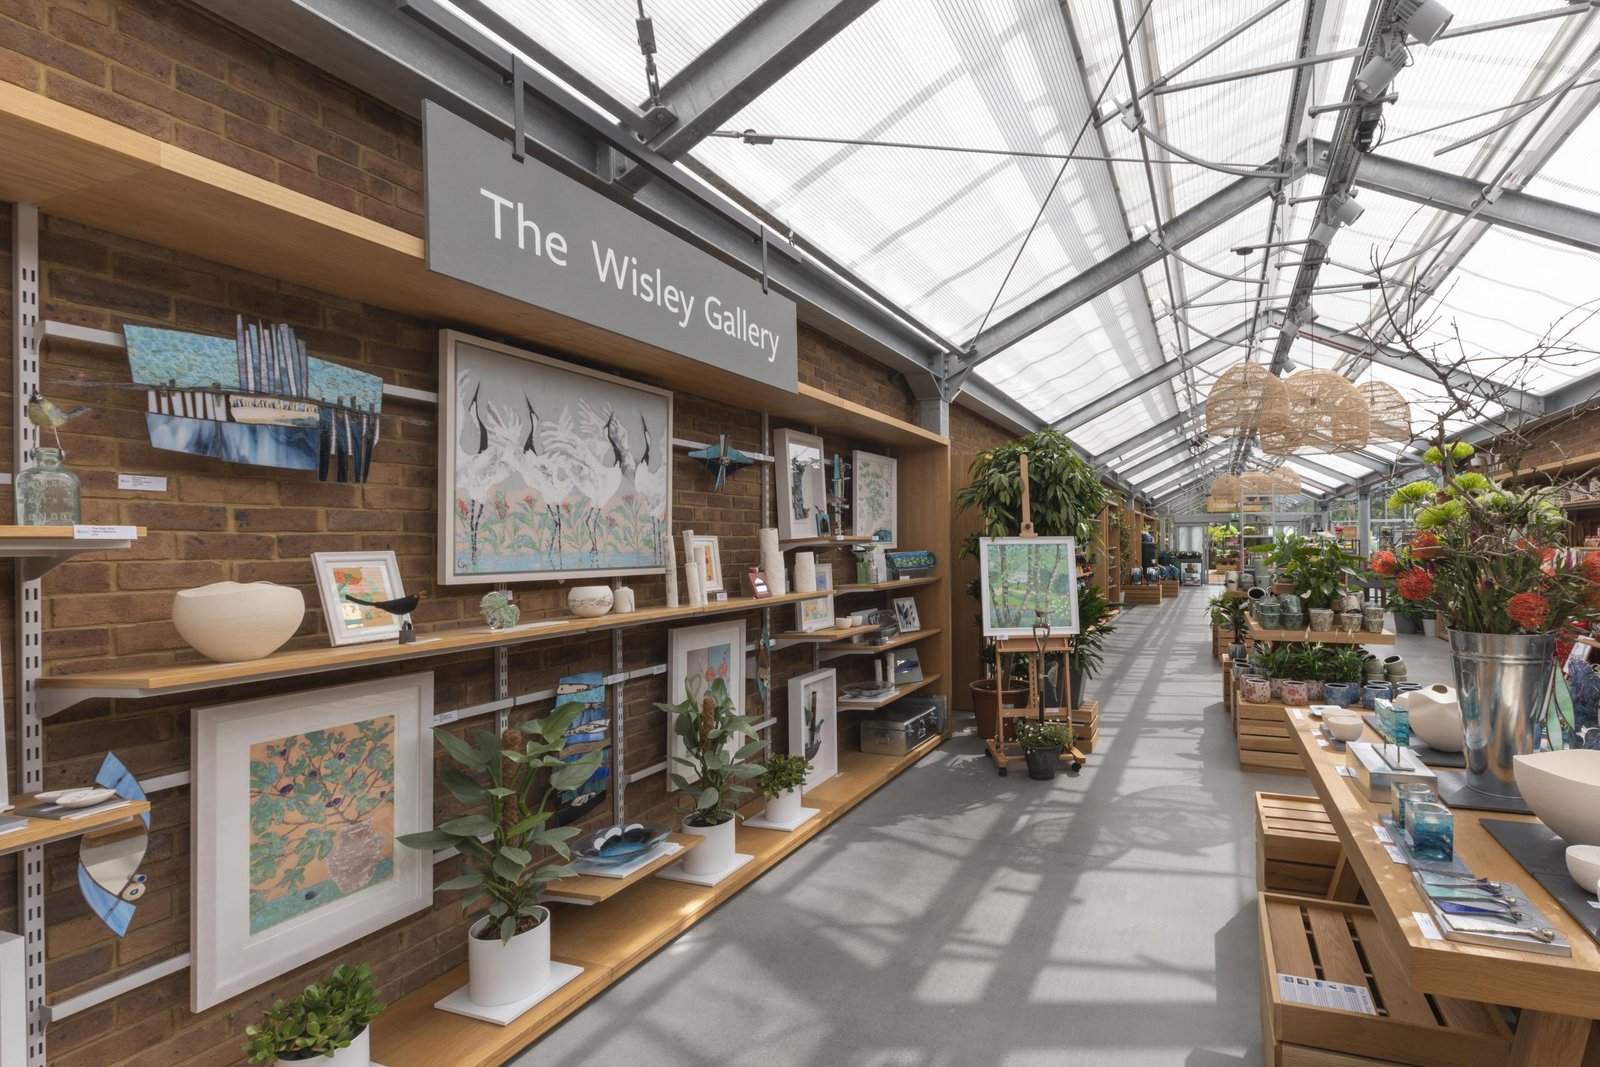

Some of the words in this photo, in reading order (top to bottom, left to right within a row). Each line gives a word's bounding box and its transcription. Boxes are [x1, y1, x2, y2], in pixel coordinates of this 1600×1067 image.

[479, 187, 568, 267] The
[591, 239, 695, 328] Wisley
[704, 295, 780, 363] Gallery
